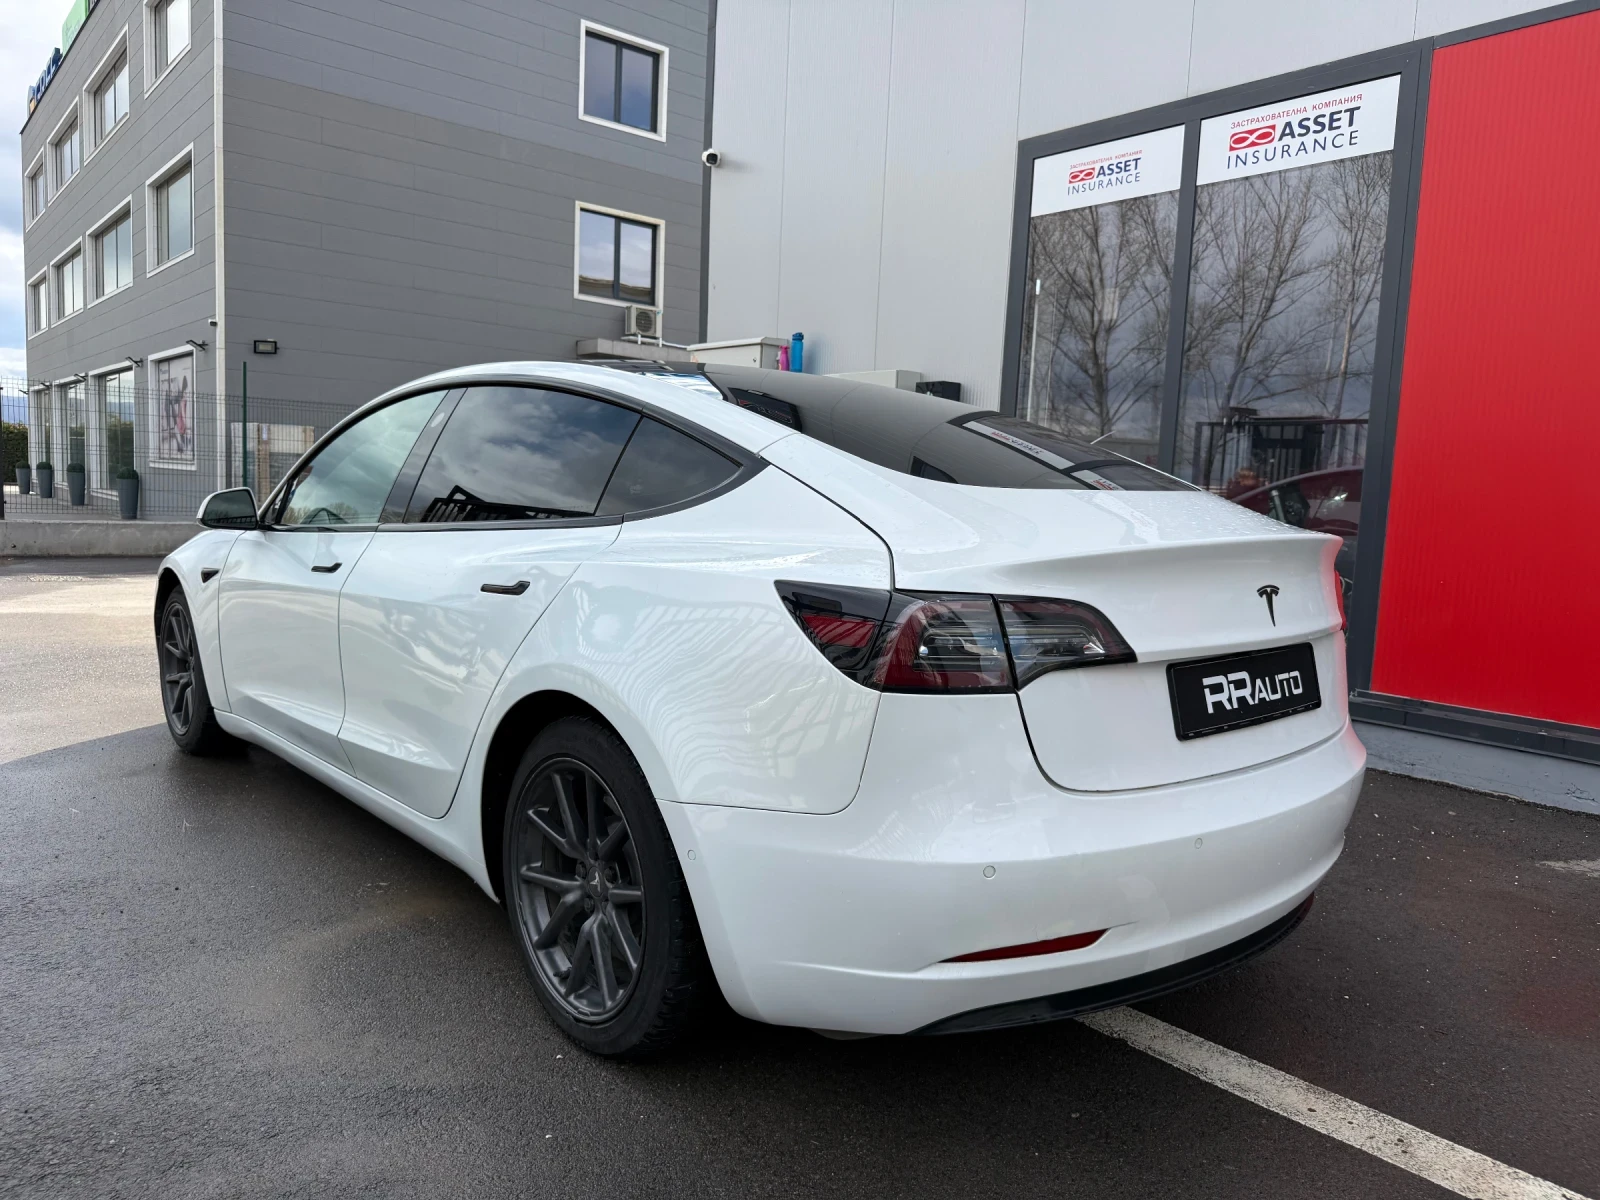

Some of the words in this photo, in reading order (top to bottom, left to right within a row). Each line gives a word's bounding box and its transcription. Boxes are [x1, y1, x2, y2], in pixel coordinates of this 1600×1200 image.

[1230, 106, 1308, 130] ЗАСТРАХОВАТЕЛНА
[1312, 93, 1363, 112] КОМПАНИЯ
[1278, 106, 1361, 142] ASSET
[1227, 130, 1359, 169] INSURANCE
[1068, 172, 1141, 196] INSURANCE
[1096, 157, 1142, 179] ASSET
